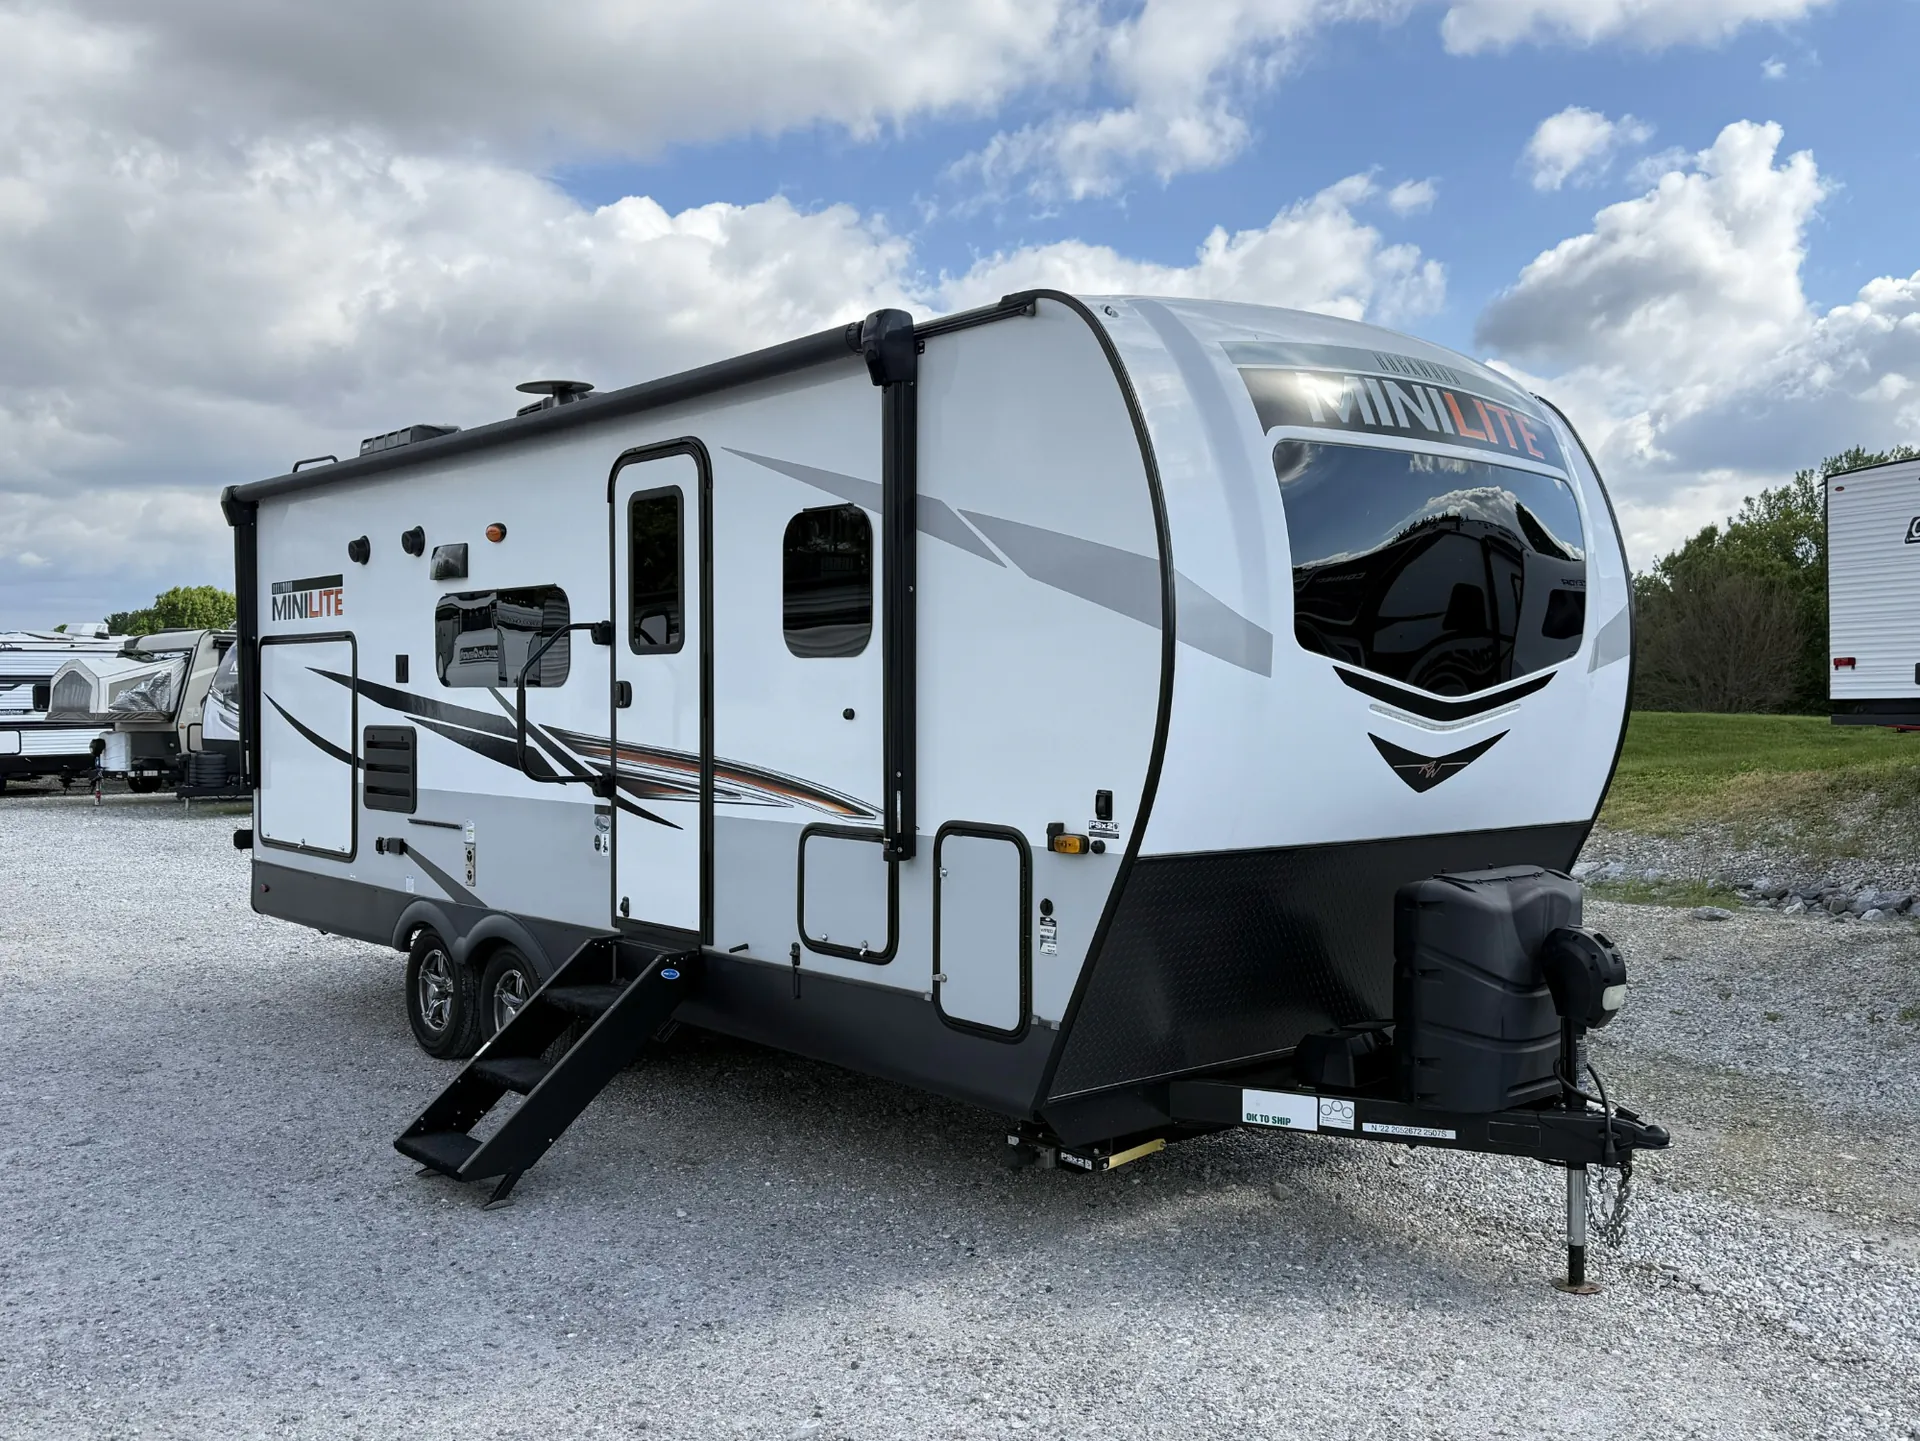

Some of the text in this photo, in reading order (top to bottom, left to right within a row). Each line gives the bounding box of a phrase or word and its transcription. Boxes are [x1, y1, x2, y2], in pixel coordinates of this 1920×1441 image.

[1294, 371, 1546, 461] MINILITE
[272, 588, 343, 621] MINILITE
[1246, 1112, 1291, 1126] OK TO SHIP
